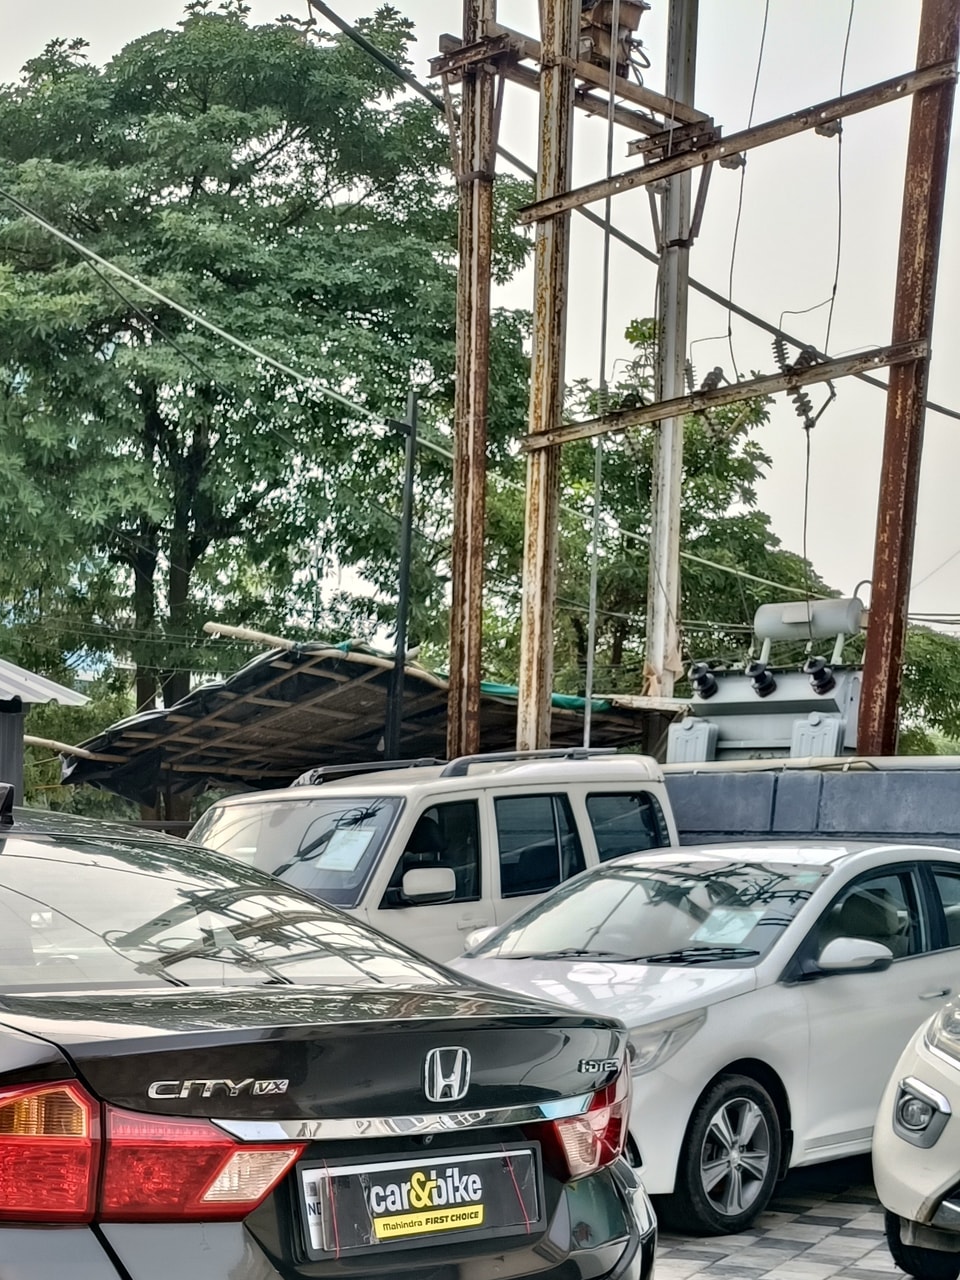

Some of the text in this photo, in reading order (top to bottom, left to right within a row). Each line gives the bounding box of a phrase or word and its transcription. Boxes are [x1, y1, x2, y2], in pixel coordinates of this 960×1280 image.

[147, 1079, 289, 1099] CITY VX
[370, 1167, 483, 1214] car&bike
[382, 1211, 480, 1232] Mahindra FIRST CHOICE
